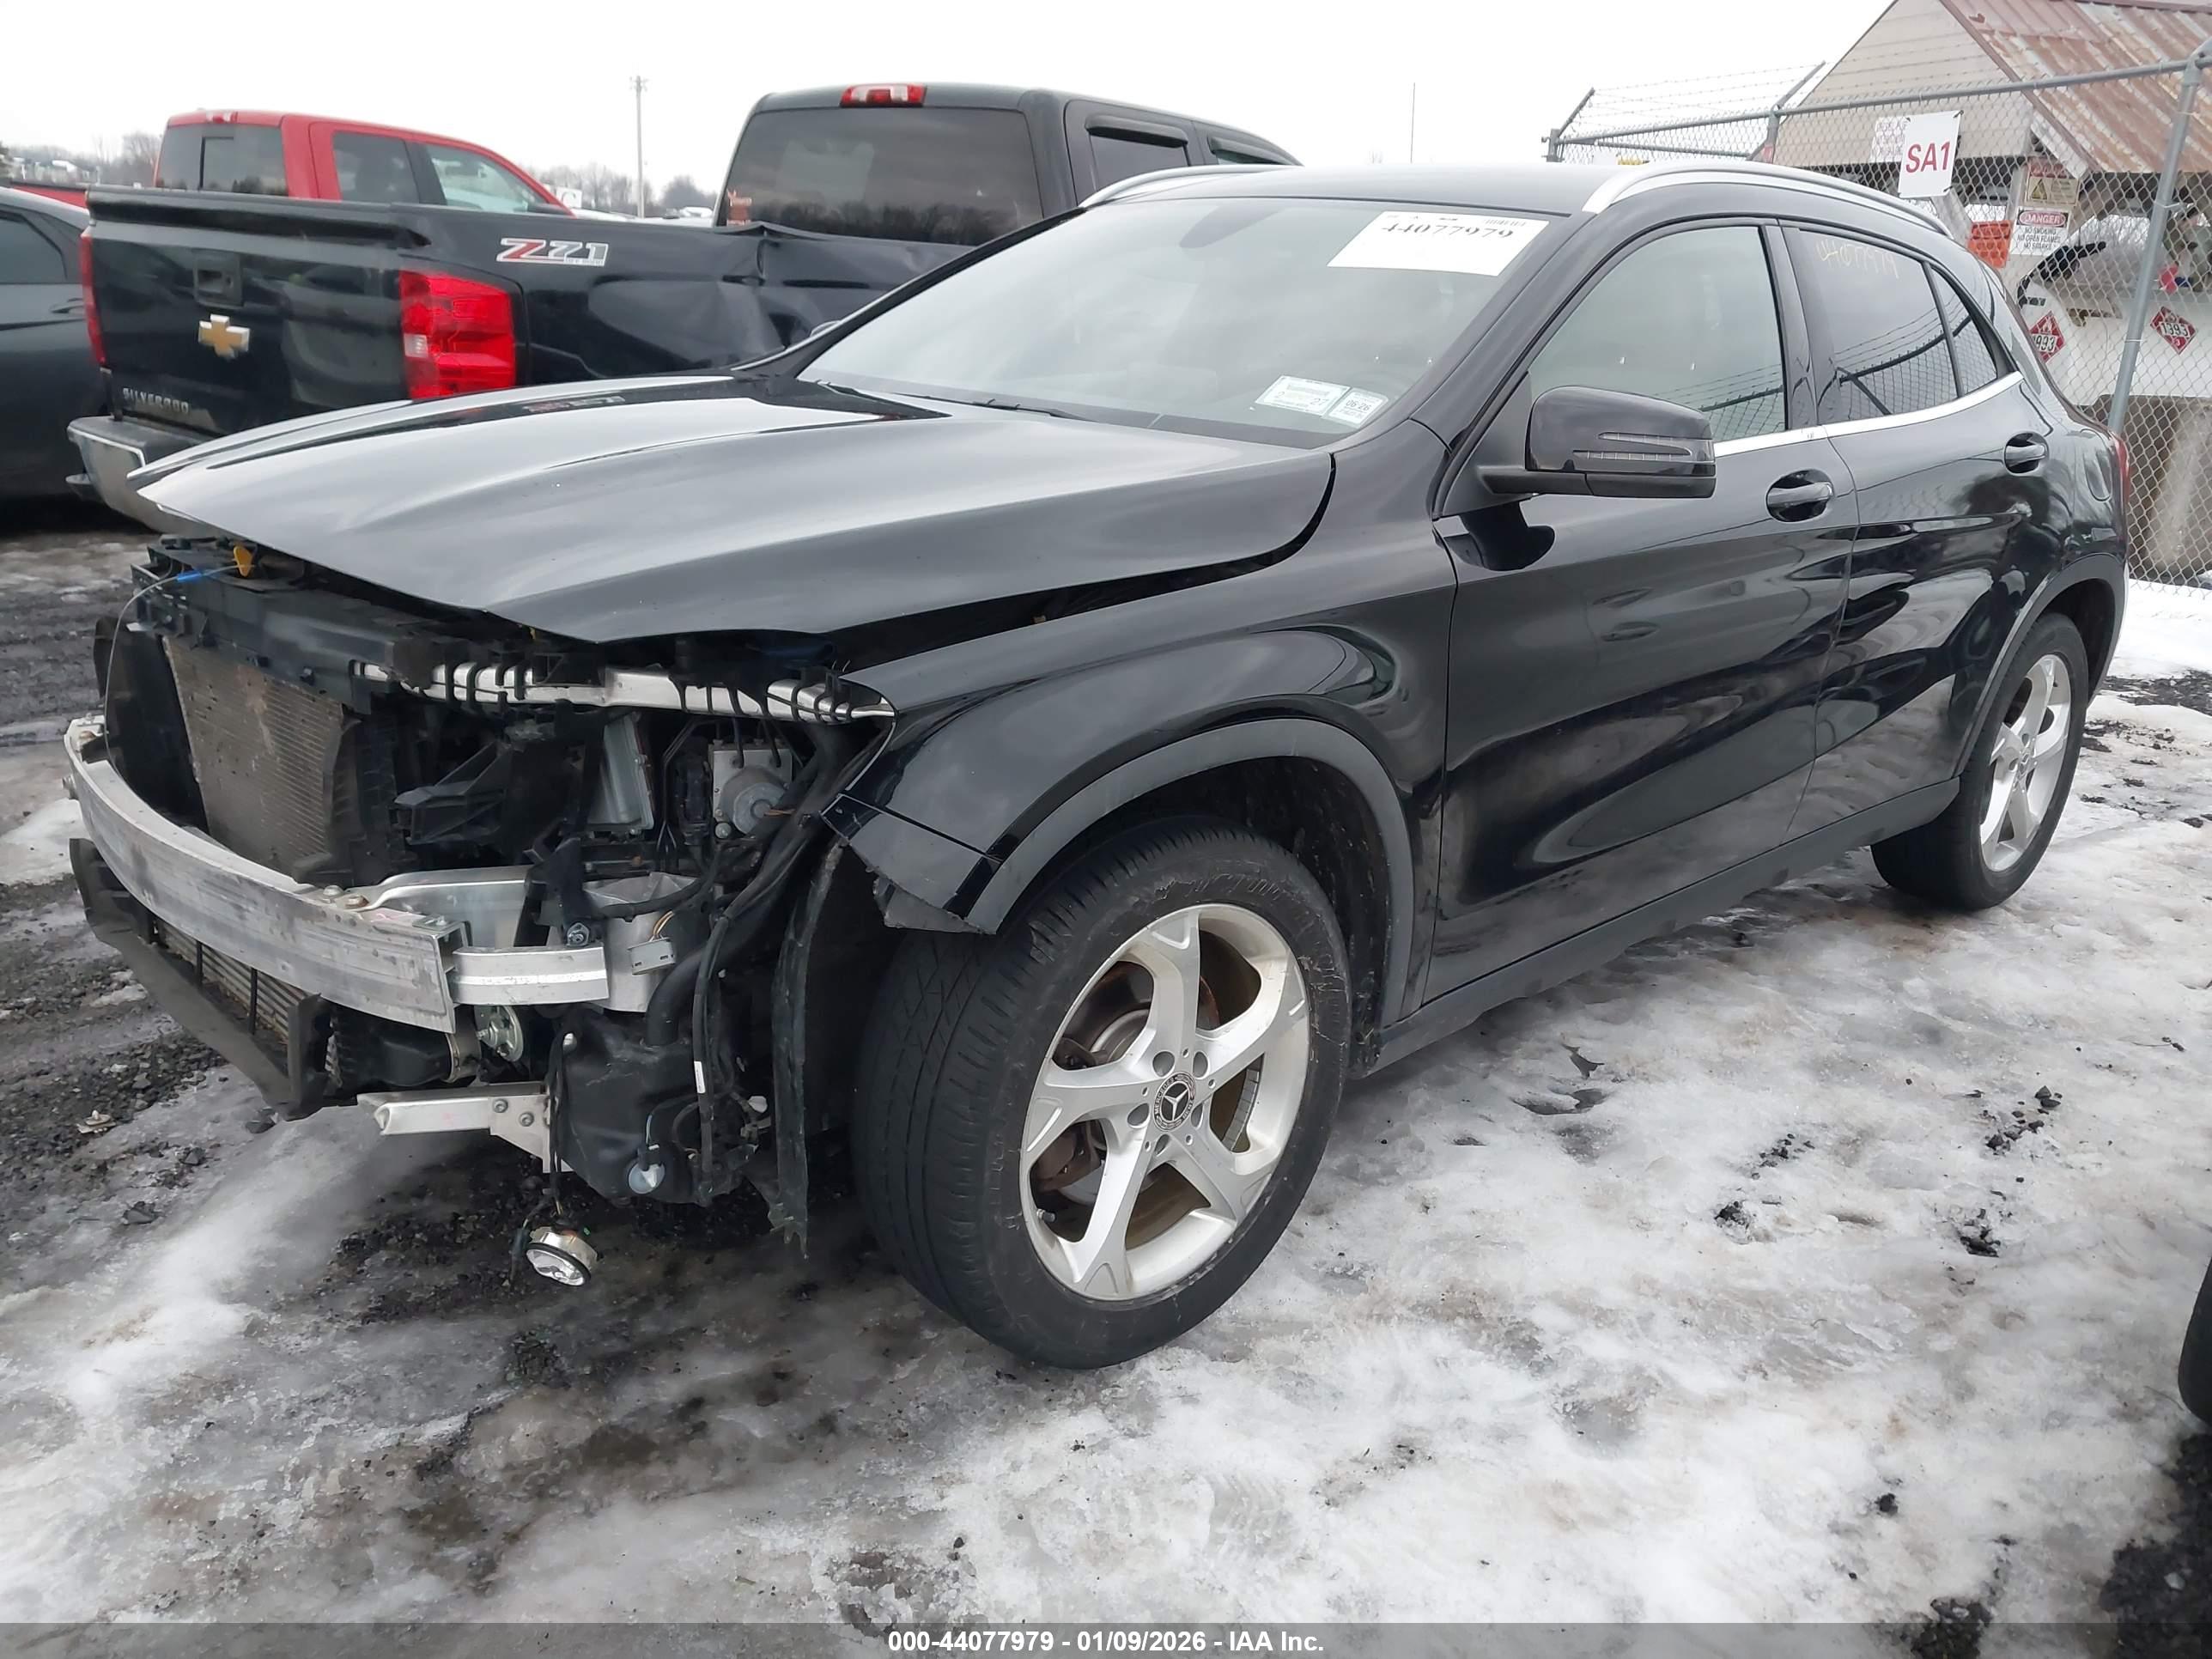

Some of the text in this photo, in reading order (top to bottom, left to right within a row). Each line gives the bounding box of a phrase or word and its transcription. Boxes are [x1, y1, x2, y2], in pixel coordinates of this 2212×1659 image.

[1906, 142, 1950, 173] SA1
[2026, 214, 2061, 223] DANGER
[496, 238, 609, 266] Z71
